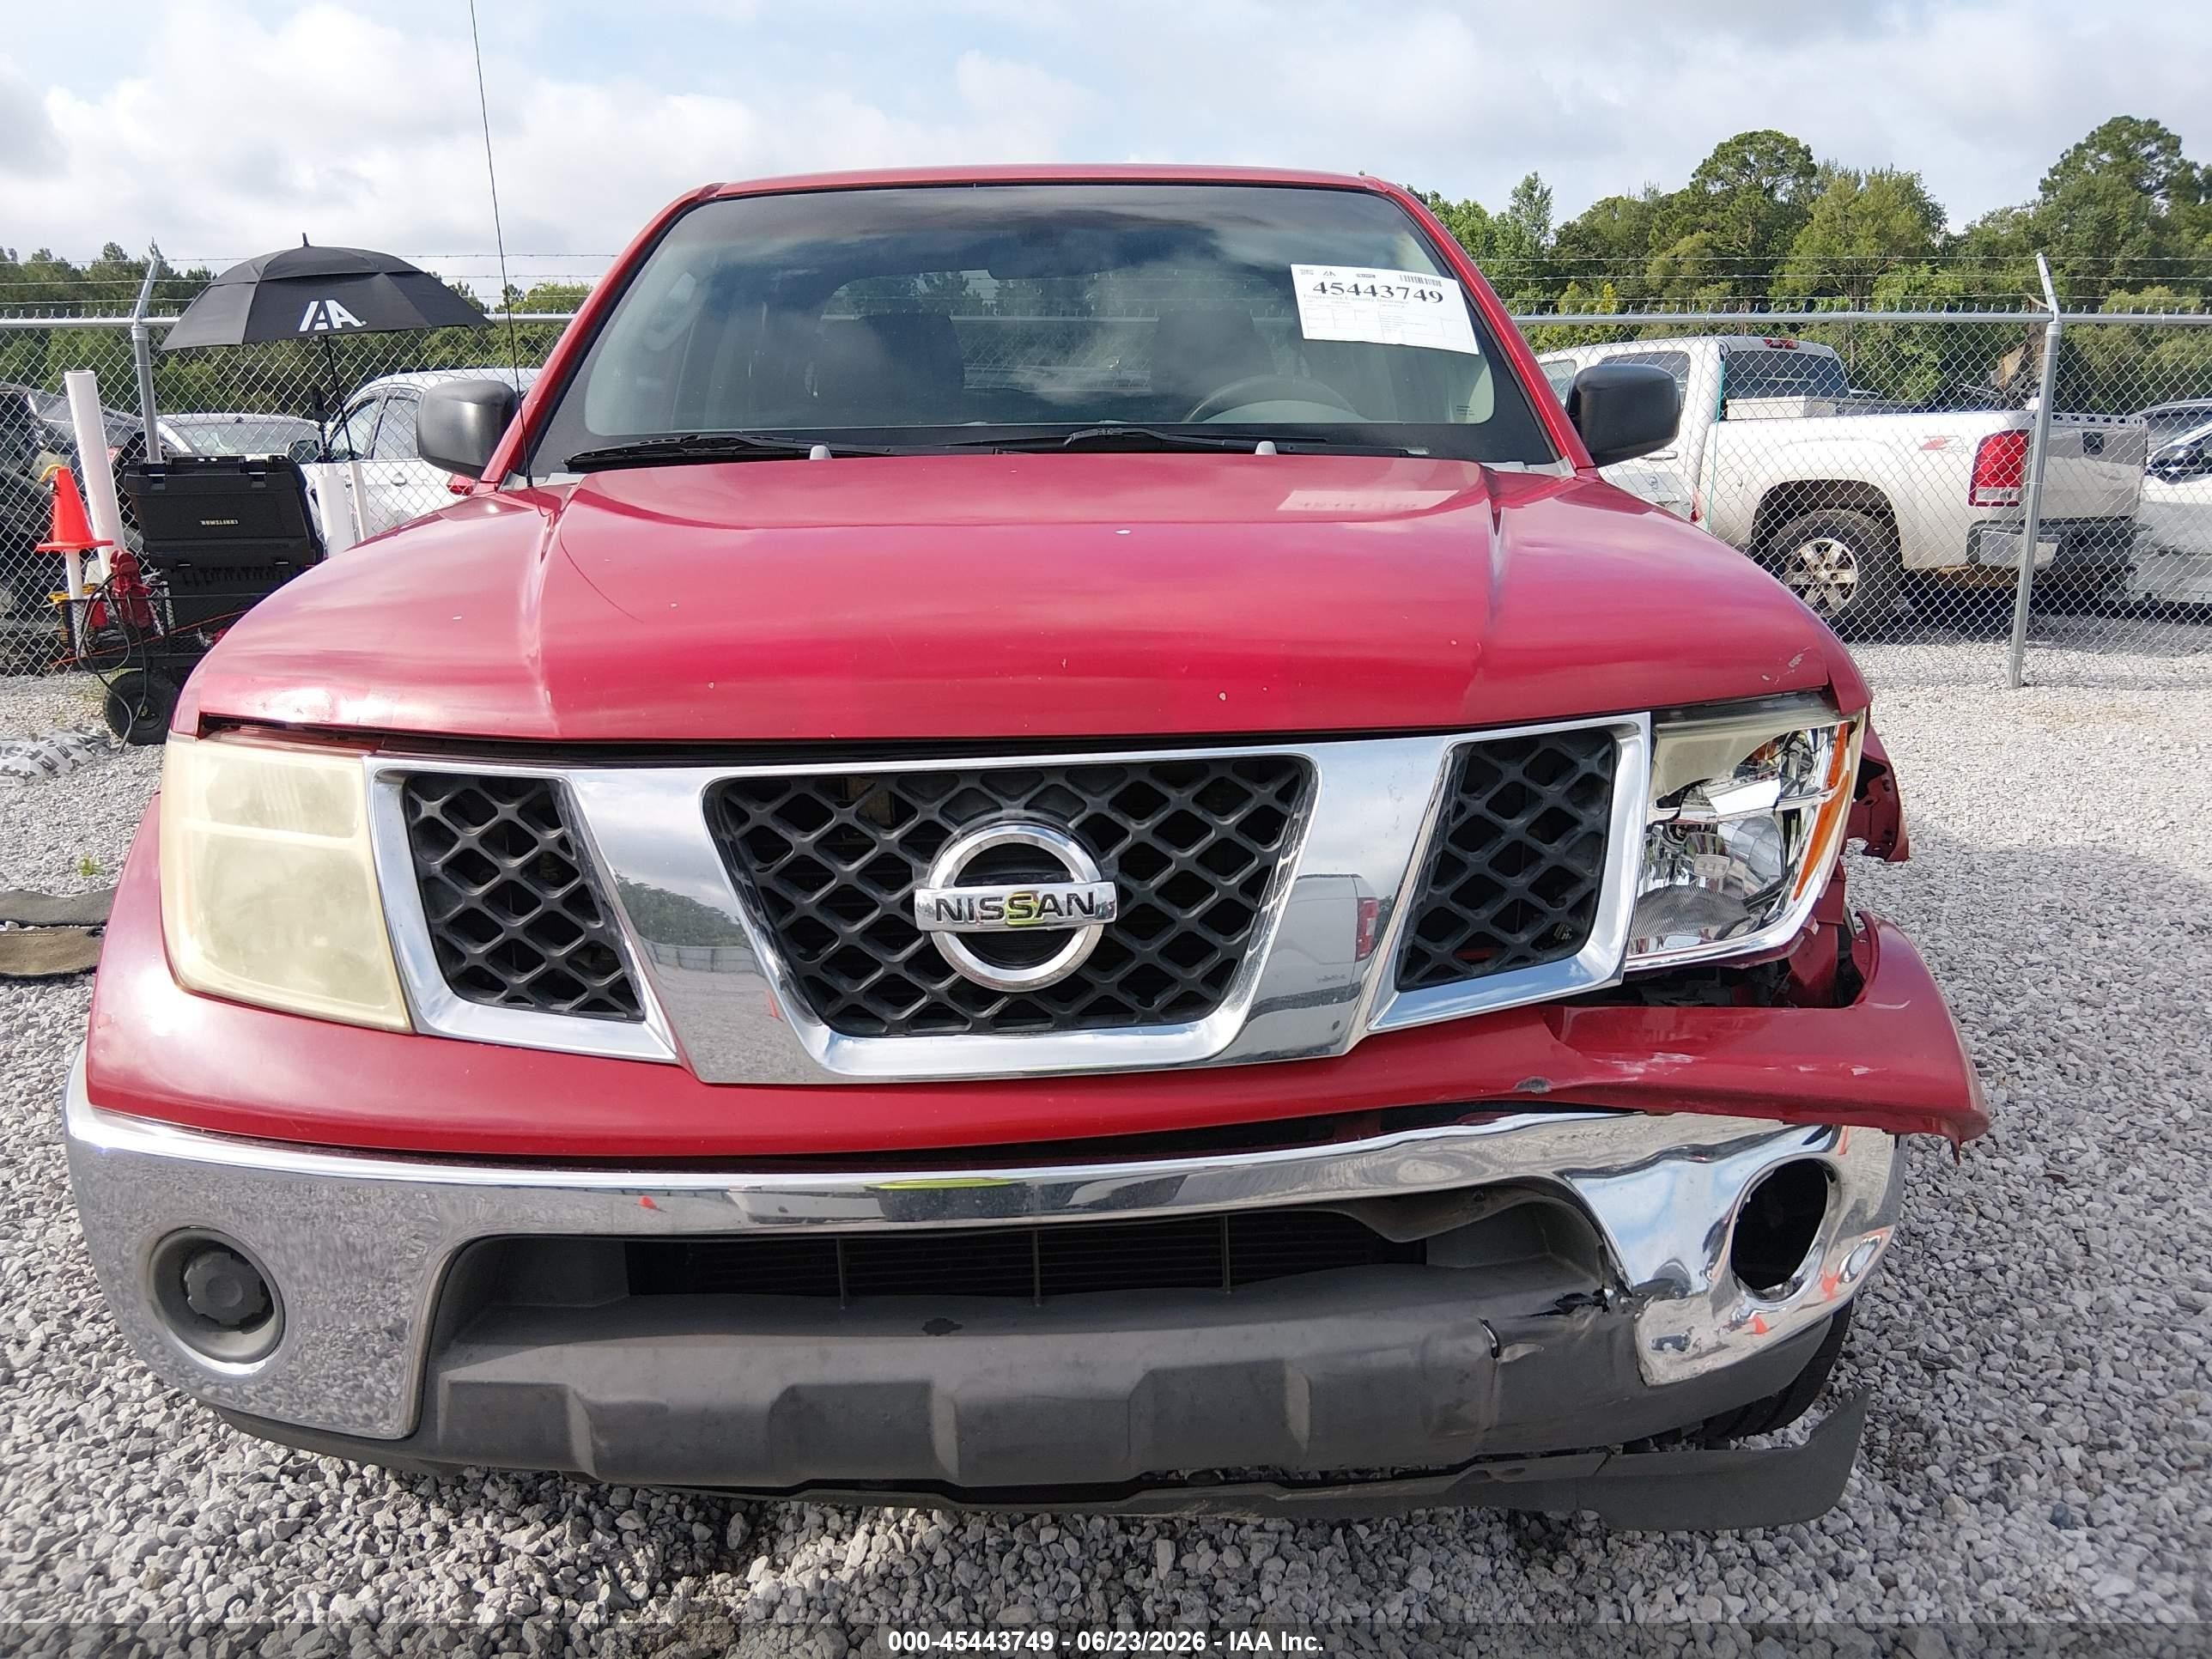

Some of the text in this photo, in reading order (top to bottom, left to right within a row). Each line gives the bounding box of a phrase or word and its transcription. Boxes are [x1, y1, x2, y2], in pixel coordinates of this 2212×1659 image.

[1312, 281, 1443, 303] 45443749
[299, 300, 364, 331] IAA
[935, 891, 1095, 922] NISSAN
